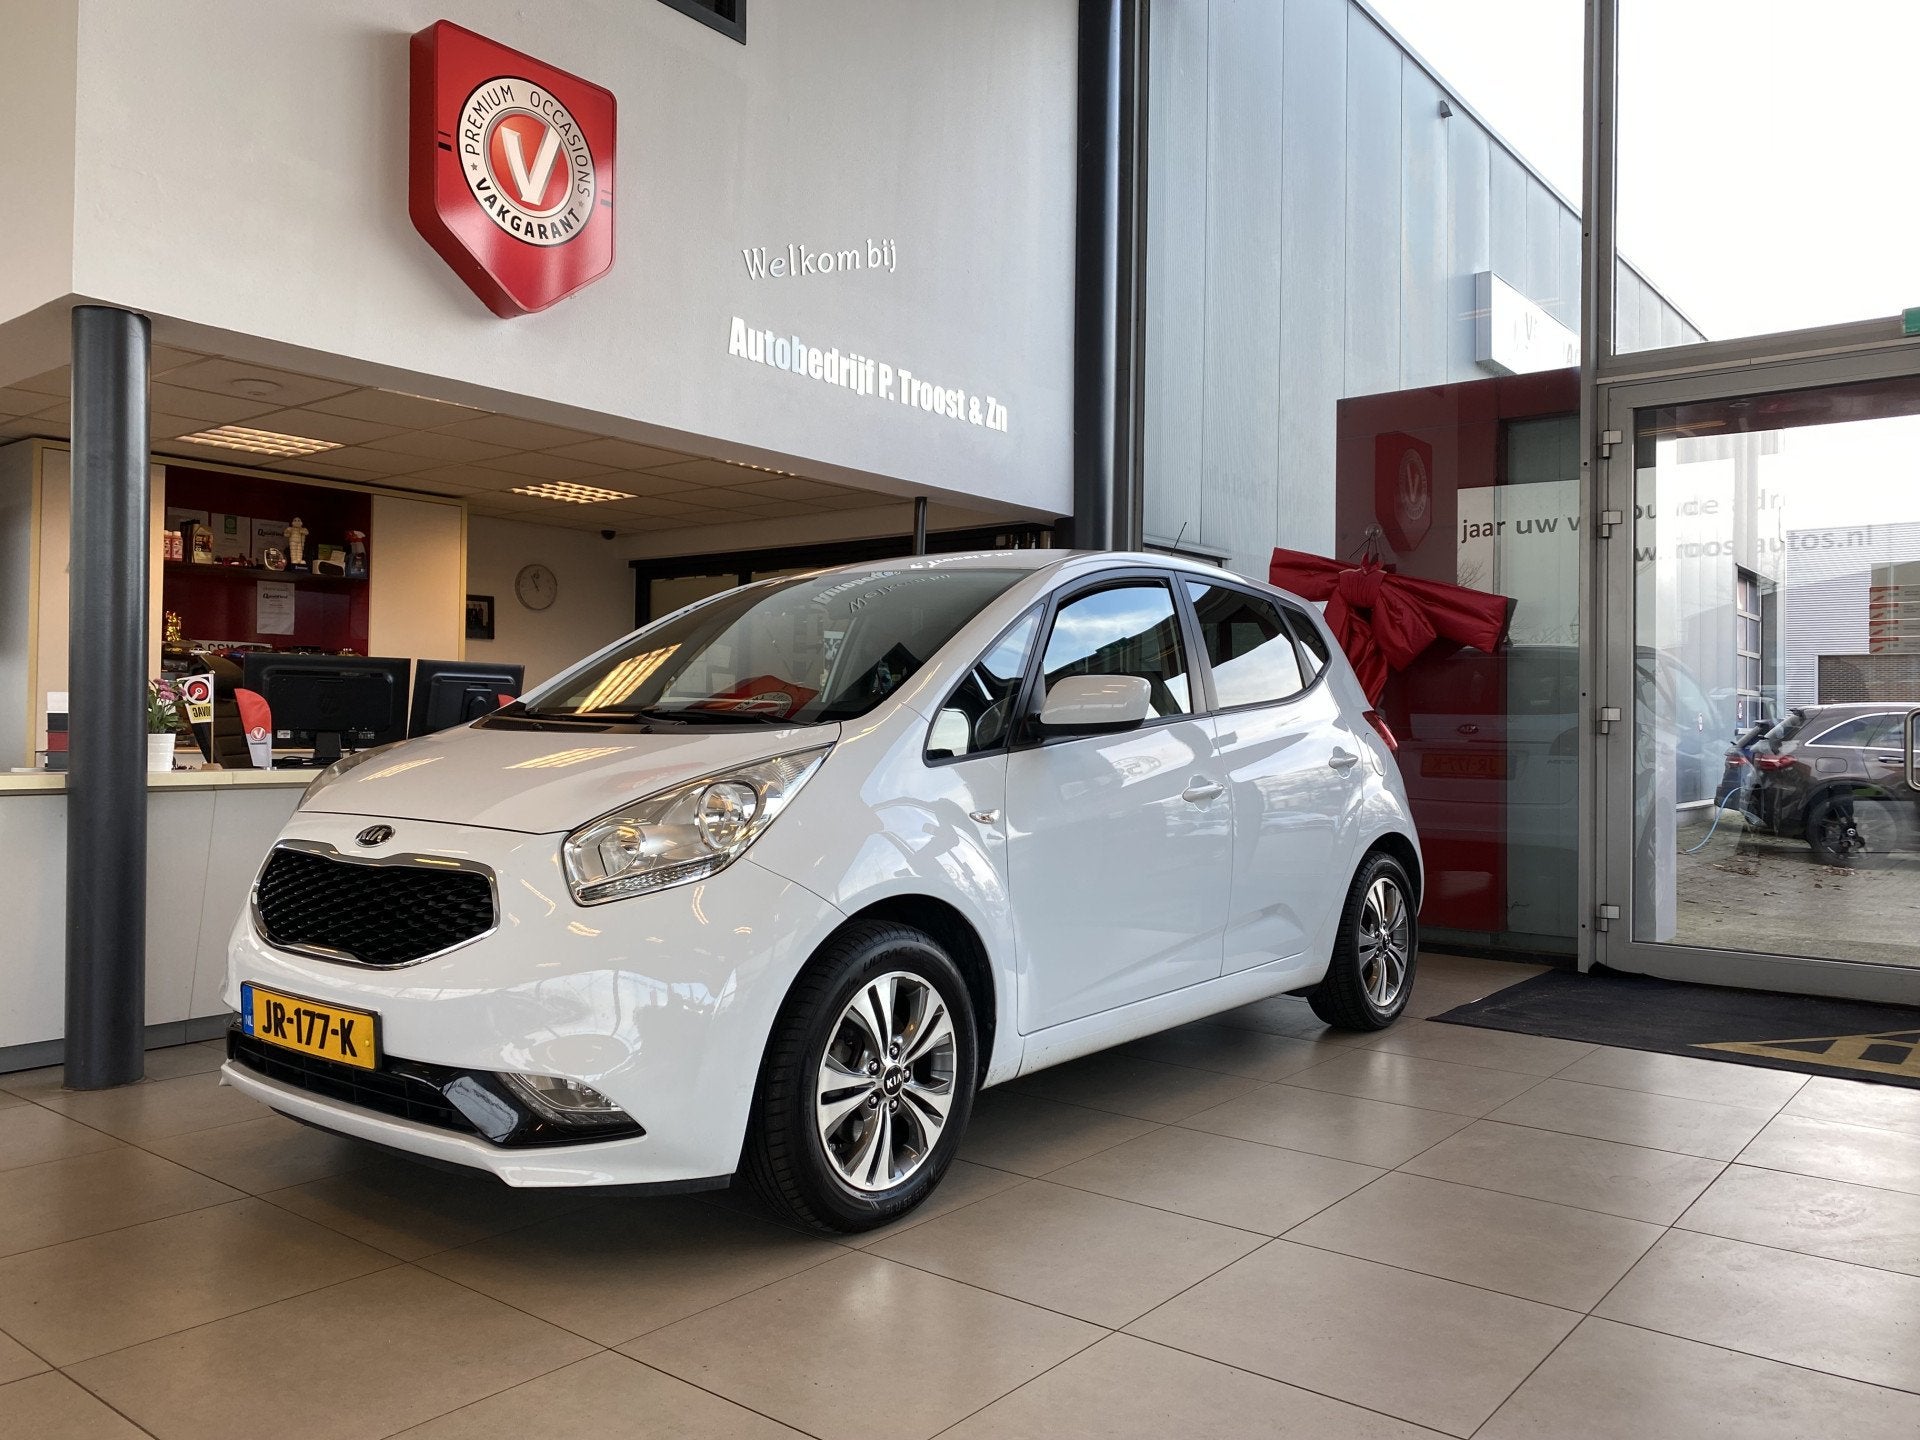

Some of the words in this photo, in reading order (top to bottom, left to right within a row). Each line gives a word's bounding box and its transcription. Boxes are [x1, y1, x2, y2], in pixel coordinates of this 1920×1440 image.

[465, 85, 515, 156] PREMIUM
[530, 91, 591, 197] OCCASIONS
[500, 124, 562, 206] V
[475, 177, 580, 240] VAKGARANT
[742, 243, 861, 280] Welkom
[866, 238, 897, 273] bij
[728, 316, 875, 395] Autobedrijf
[877, 362, 894, 401] P.
[898, 368, 966, 421] Troost
[968, 396, 983, 426] &
[985, 396, 1008, 433] Zn
[1461, 520, 1506, 544] jaar
[1516, 517, 1558, 535] uw
[358, 827, 388, 842] KIA
[244, 1014, 253, 1027] NL
[262, 999, 358, 1058] JR-177-K
[886, 1073, 902, 1089] KIA
